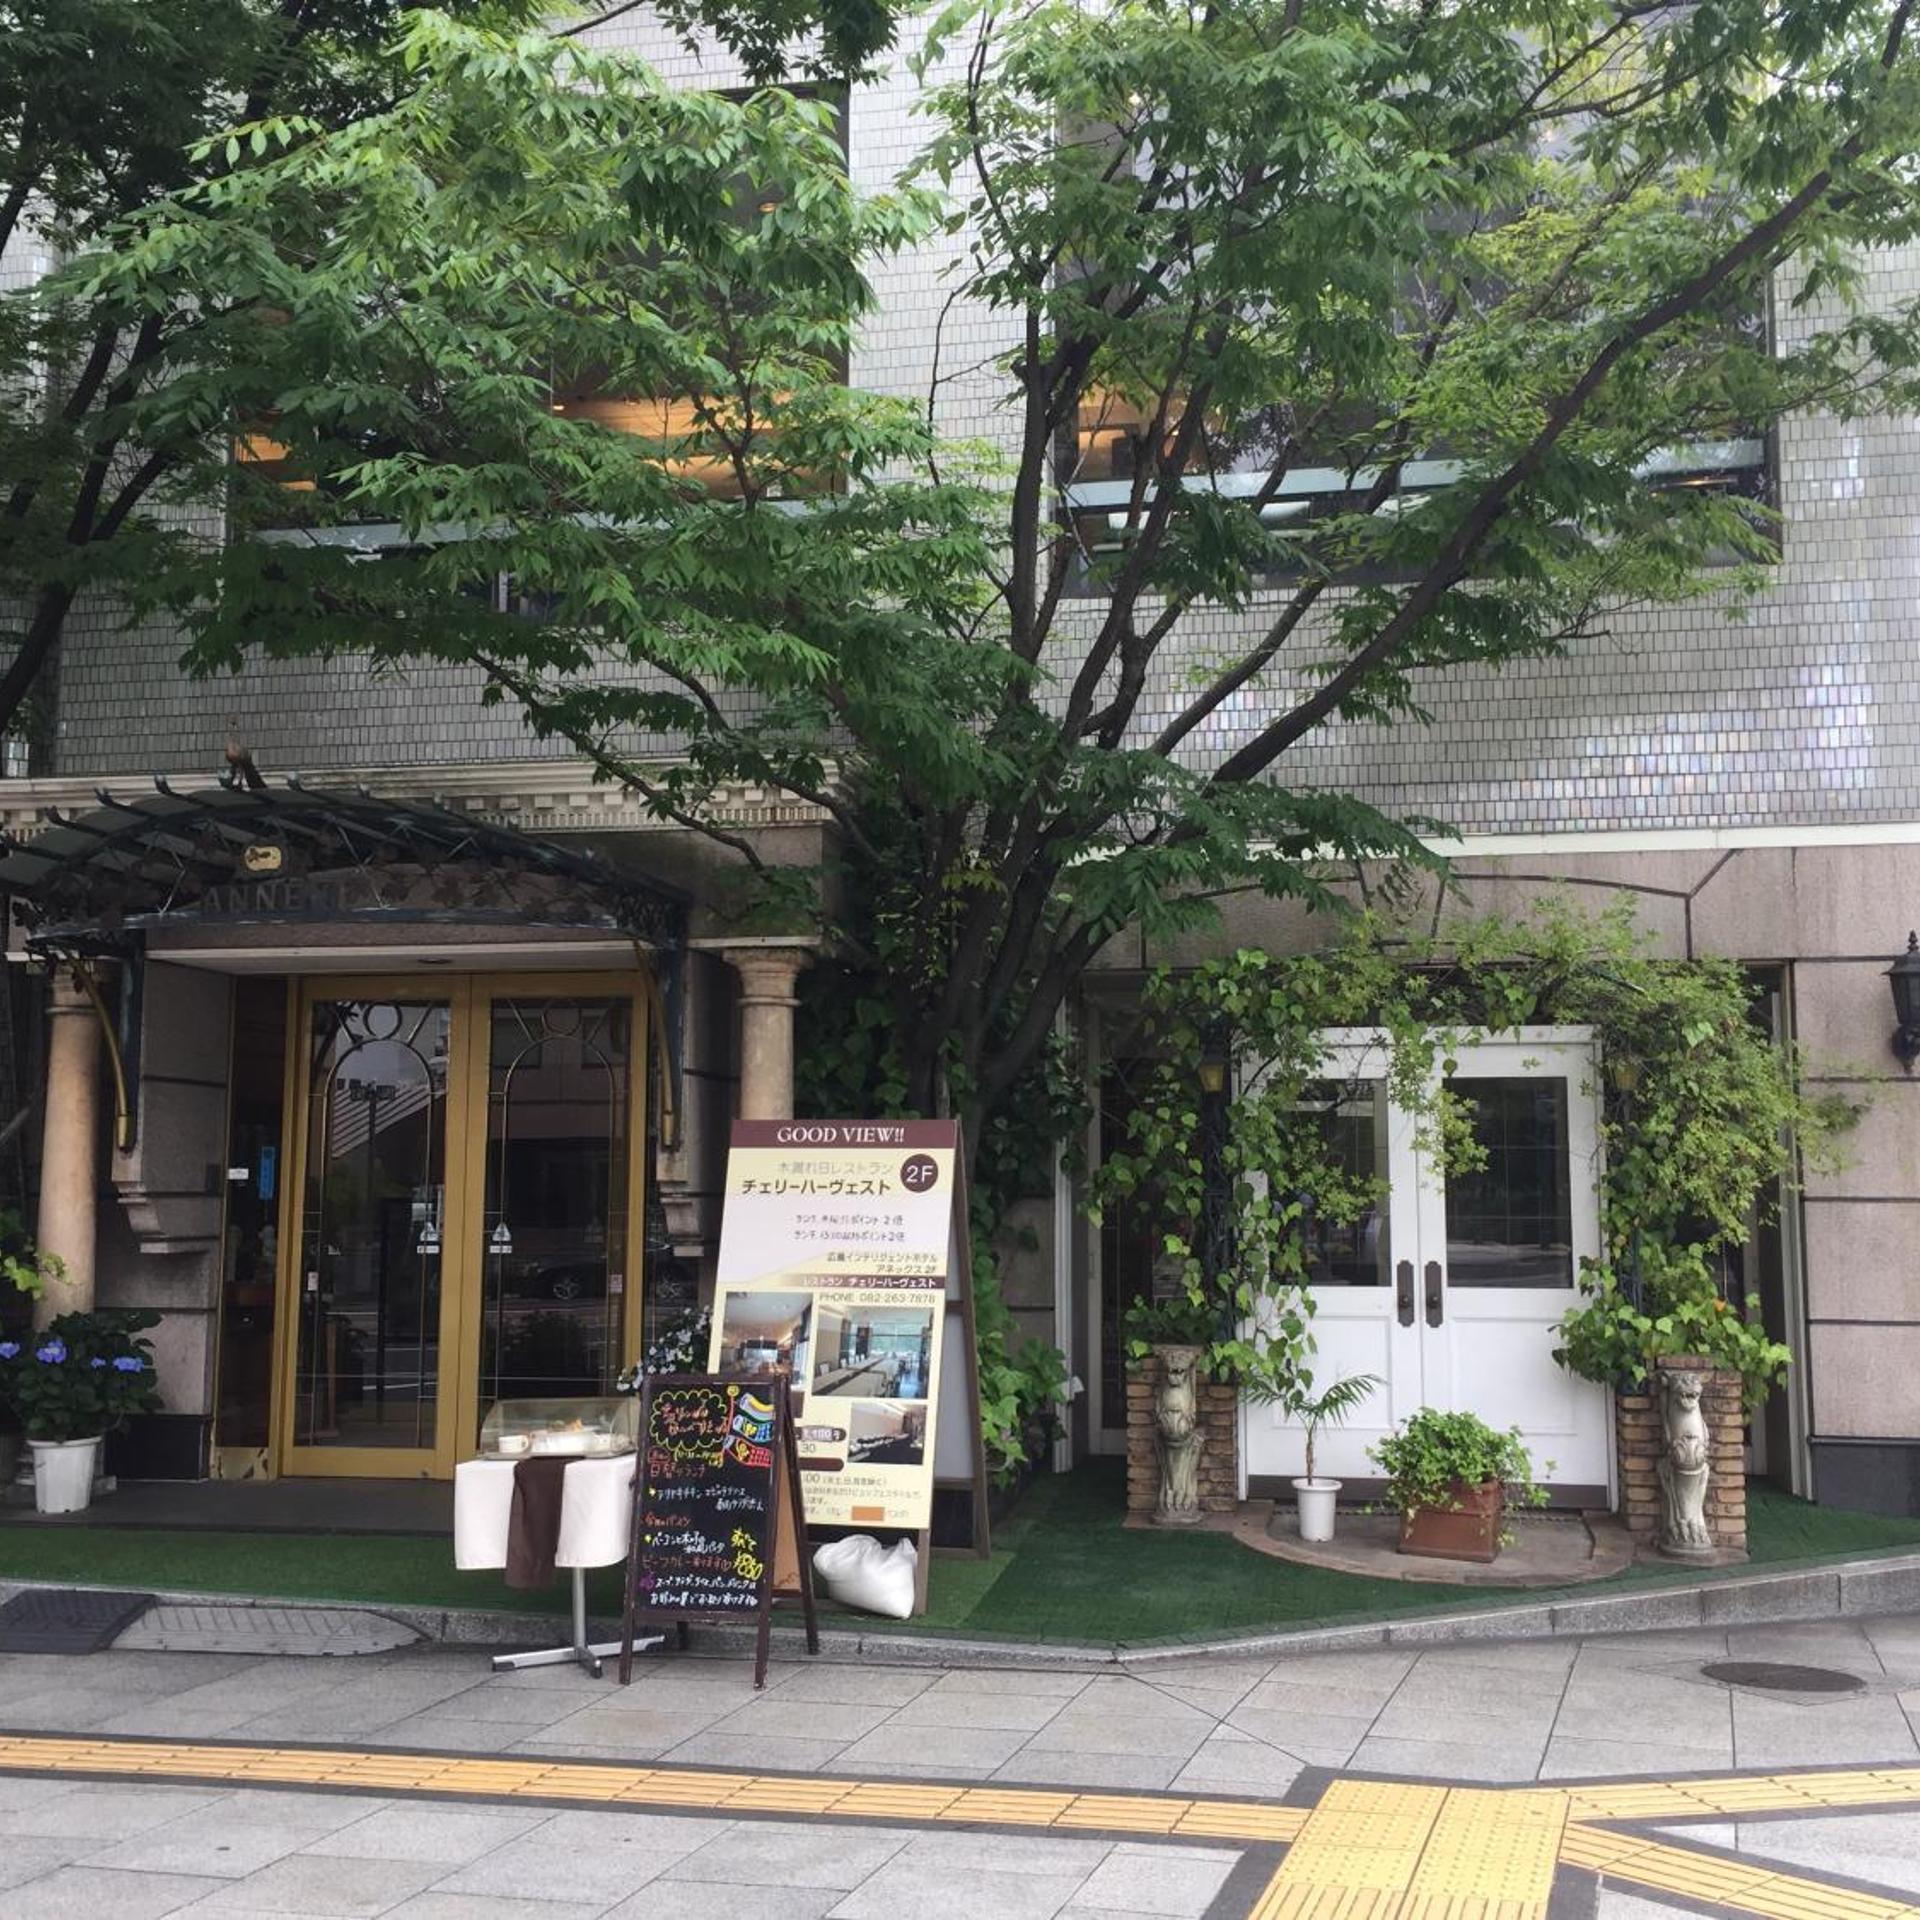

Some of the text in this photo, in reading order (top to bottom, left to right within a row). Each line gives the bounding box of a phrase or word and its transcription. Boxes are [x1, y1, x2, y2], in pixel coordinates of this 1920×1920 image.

[776, 1127, 905, 1143] GOOD VIEW!!
[905, 1164, 934, 1183] 2F
[741, 1178, 892, 1195] チェリーハーヴェスト
